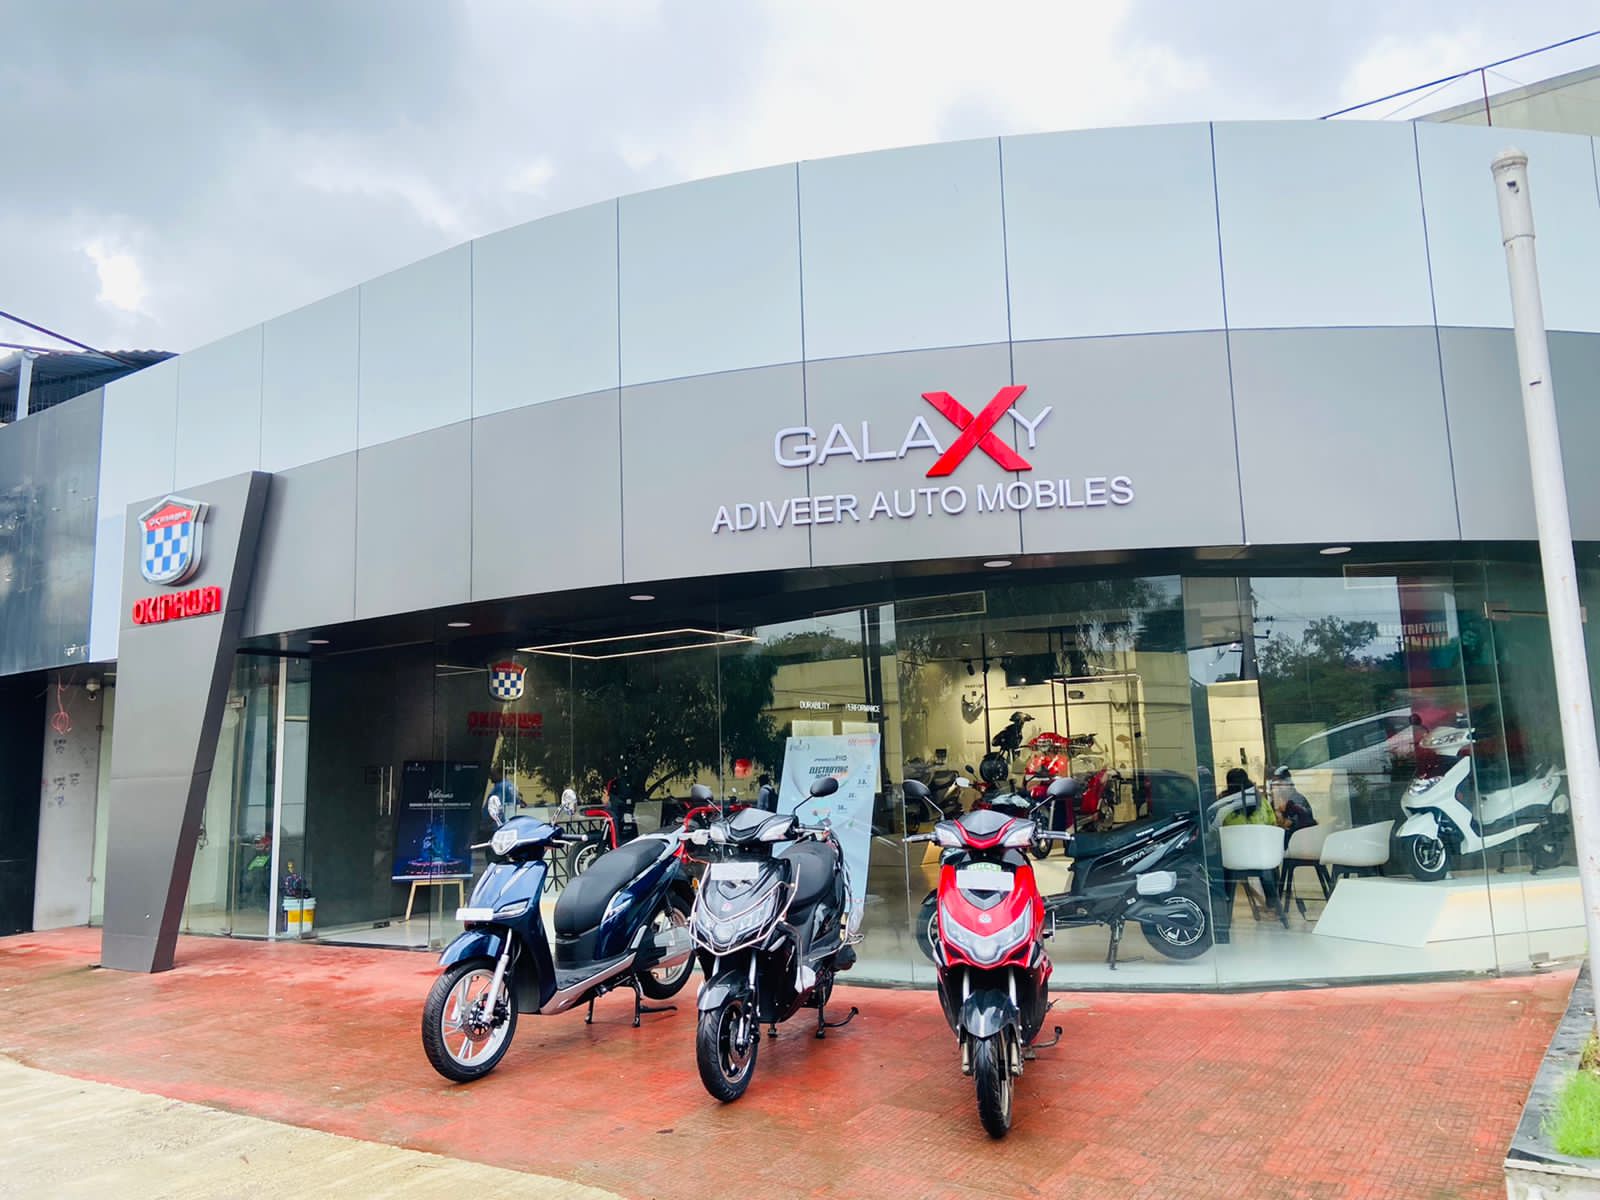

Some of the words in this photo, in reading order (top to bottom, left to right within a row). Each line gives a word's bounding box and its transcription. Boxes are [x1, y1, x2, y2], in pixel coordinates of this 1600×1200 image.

[774, 385, 1053, 478] GALAXY
[711, 493, 860, 534] ADIVEER
[868, 485, 968, 521] AUTO
[976, 475, 1135, 514] MOBILES
[132, 586, 222, 625] OKINAWA
